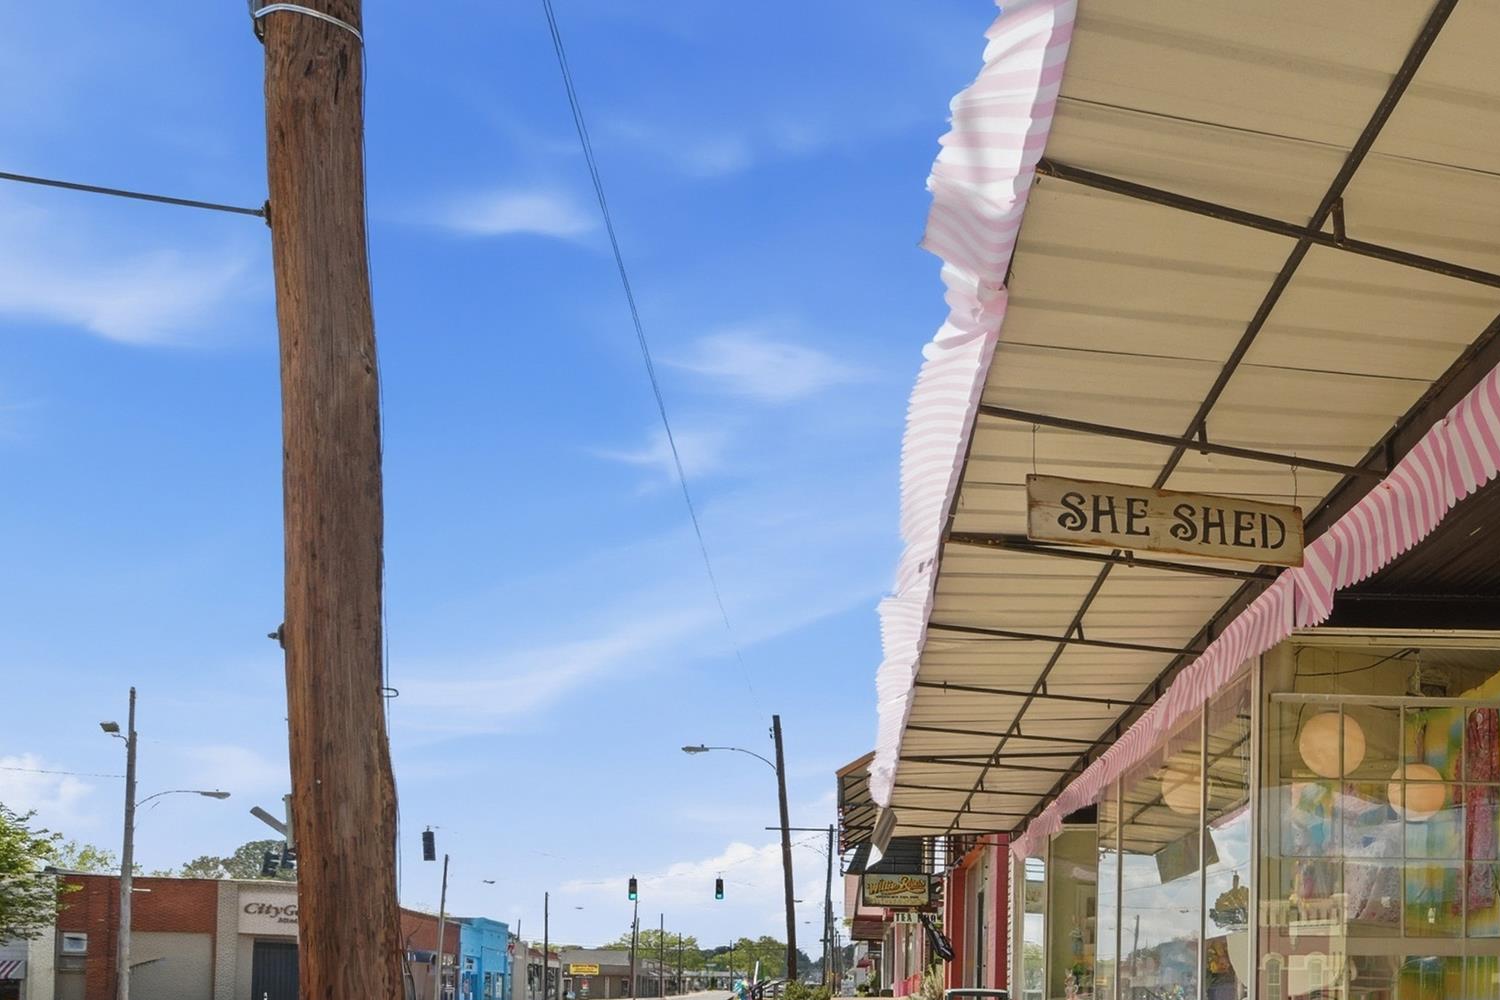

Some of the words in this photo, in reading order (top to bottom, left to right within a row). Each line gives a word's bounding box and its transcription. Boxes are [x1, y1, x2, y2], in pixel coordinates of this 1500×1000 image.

[1057, 491, 1150, 536] SHE
[1169, 503, 1287, 550] SHED
[896, 913, 912, 922] TEA
